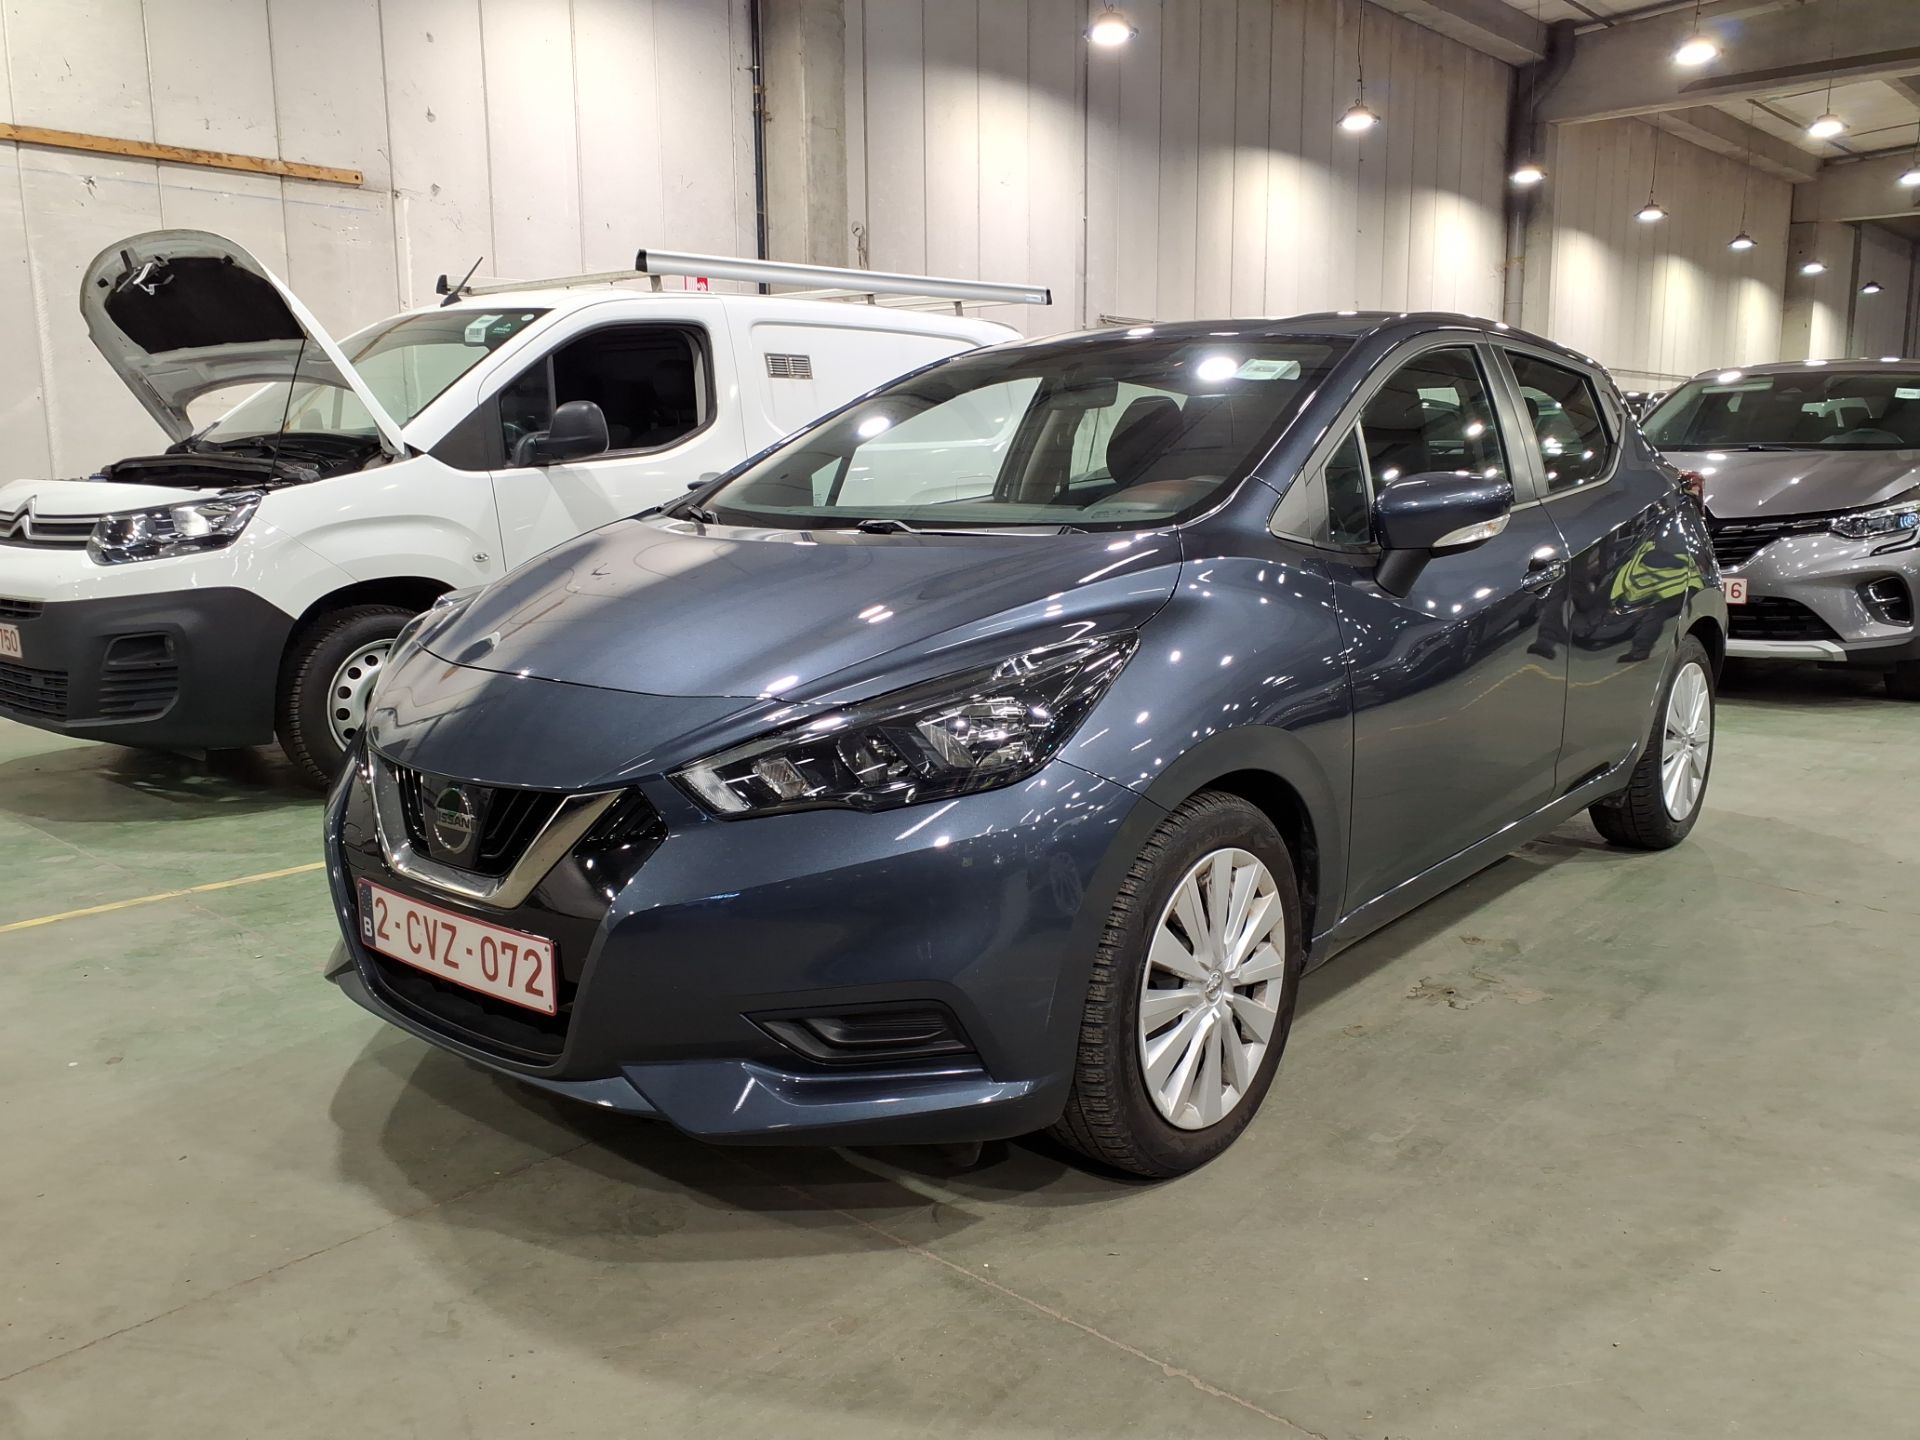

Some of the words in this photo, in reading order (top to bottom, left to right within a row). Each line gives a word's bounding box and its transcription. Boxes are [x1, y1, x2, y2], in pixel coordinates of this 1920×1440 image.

[436, 809, 470, 829] ISSAN
[363, 917, 373, 937] B
[375, 897, 544, 997] 2-CVZ-072
